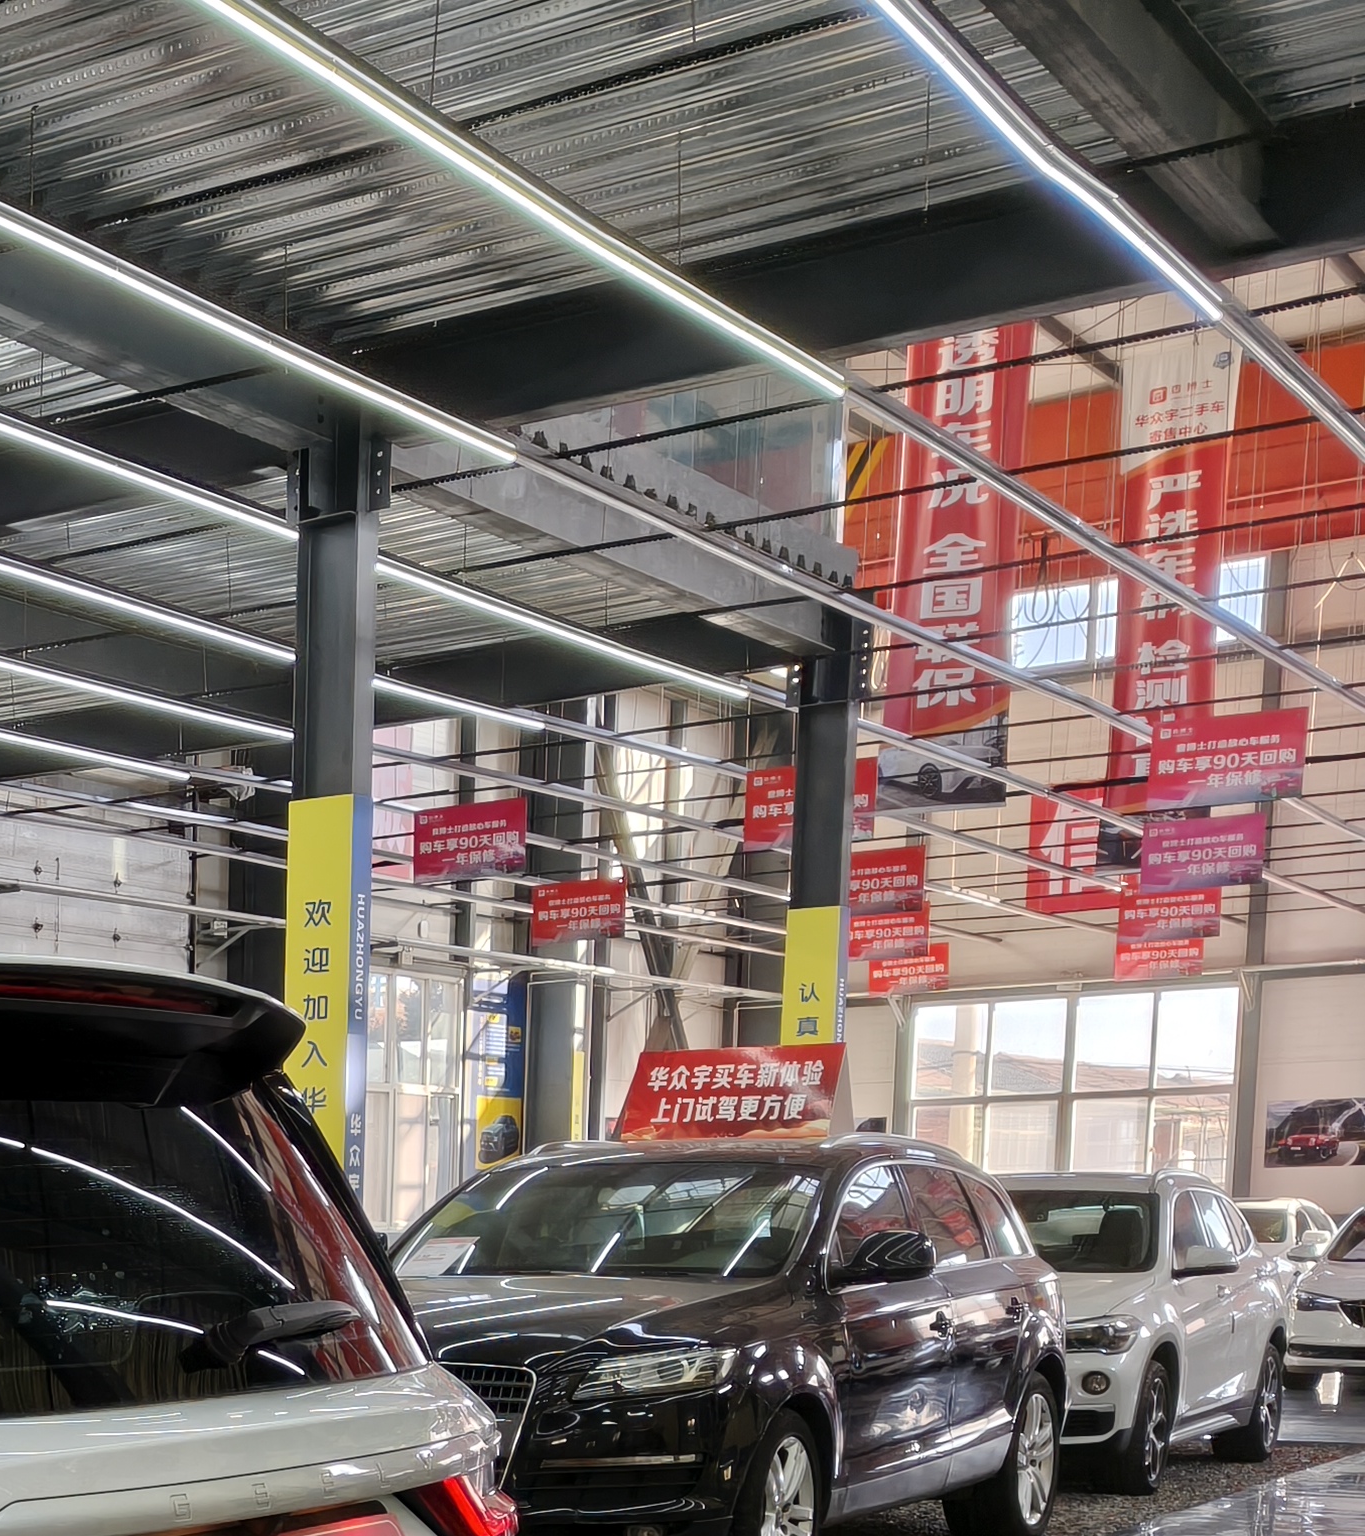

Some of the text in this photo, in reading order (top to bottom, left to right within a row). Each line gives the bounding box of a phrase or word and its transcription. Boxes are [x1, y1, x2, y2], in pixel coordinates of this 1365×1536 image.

[1135, 400, 1225, 428] 华众宇二手车
[1158, 748, 1297, 775] 购车享90天回购
[1188, 769, 1263, 788] 一年保修
[419, 831, 519, 855] 购车享90天回购
[1148, 844, 1257, 866] 购车享90天回购
[850, 925, 925, 941] 车享90天回购
[354, 893, 366, 1021] HUAZHONGYU
[301, 898, 332, 1114] 欢迎加入华
[796, 983, 820, 1037] 认真
[647, 1059, 825, 1092] 华众宇买车新体验
[650, 1093, 807, 1125] 上门试驾更方便
